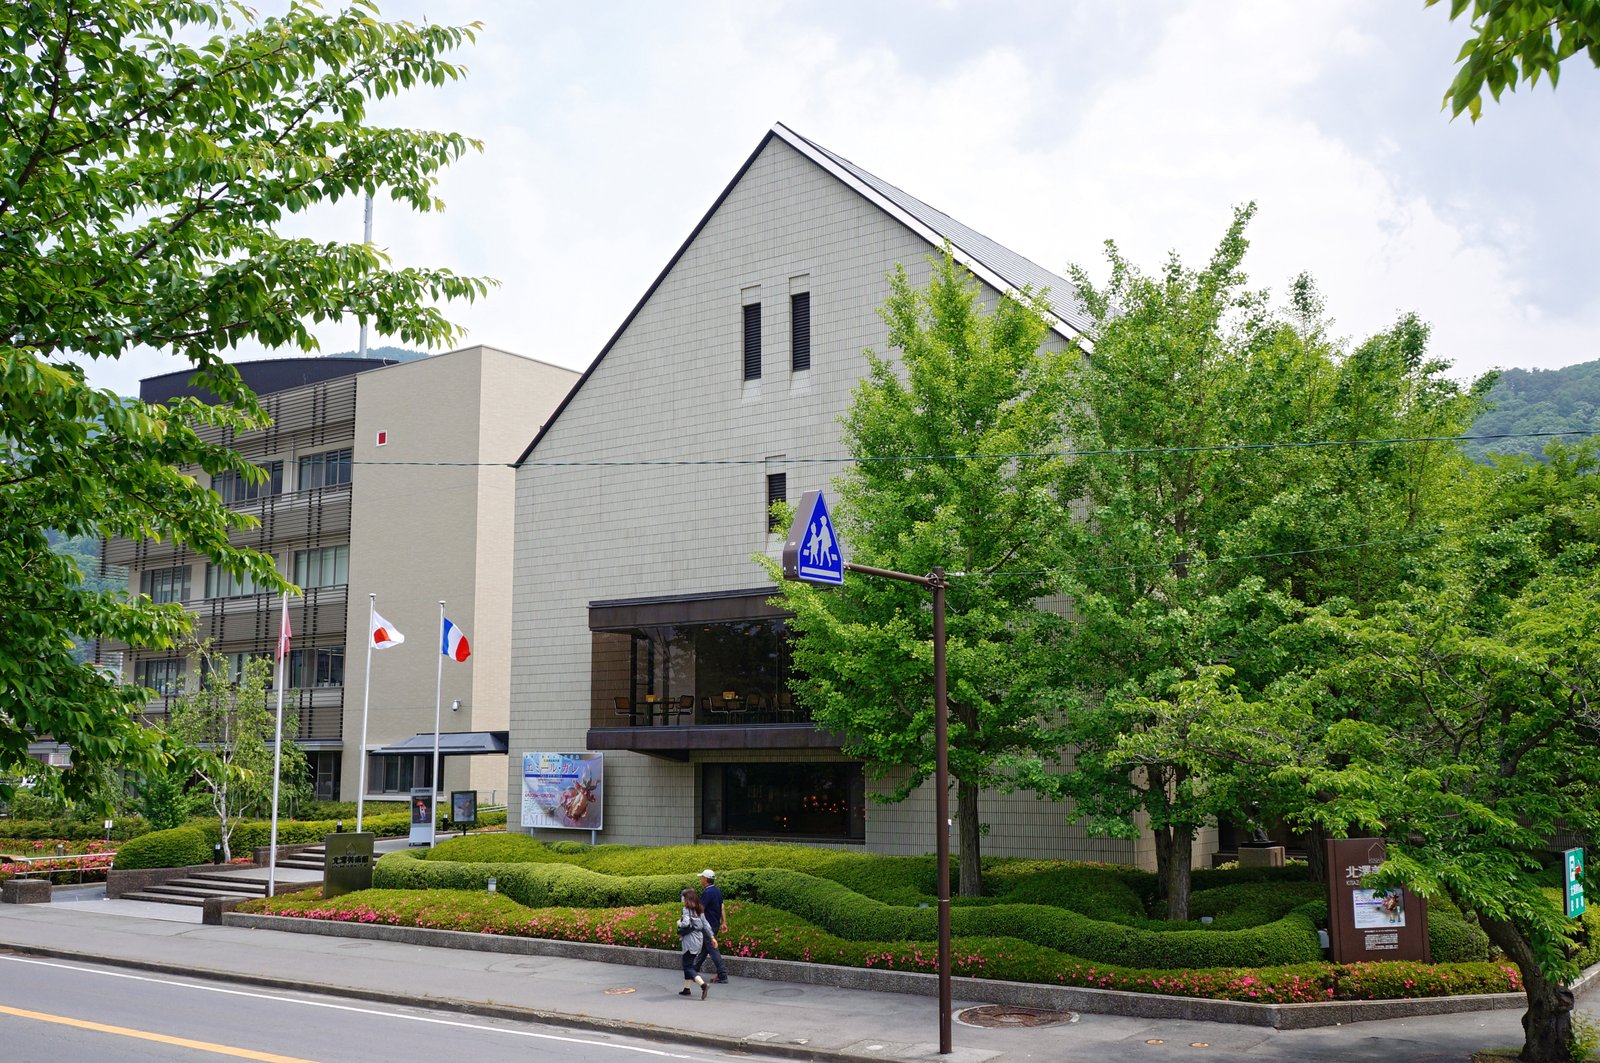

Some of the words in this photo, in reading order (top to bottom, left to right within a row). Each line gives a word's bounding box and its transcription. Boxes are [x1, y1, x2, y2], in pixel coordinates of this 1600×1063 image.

[525, 762, 579, 774] エミール・ガレ
